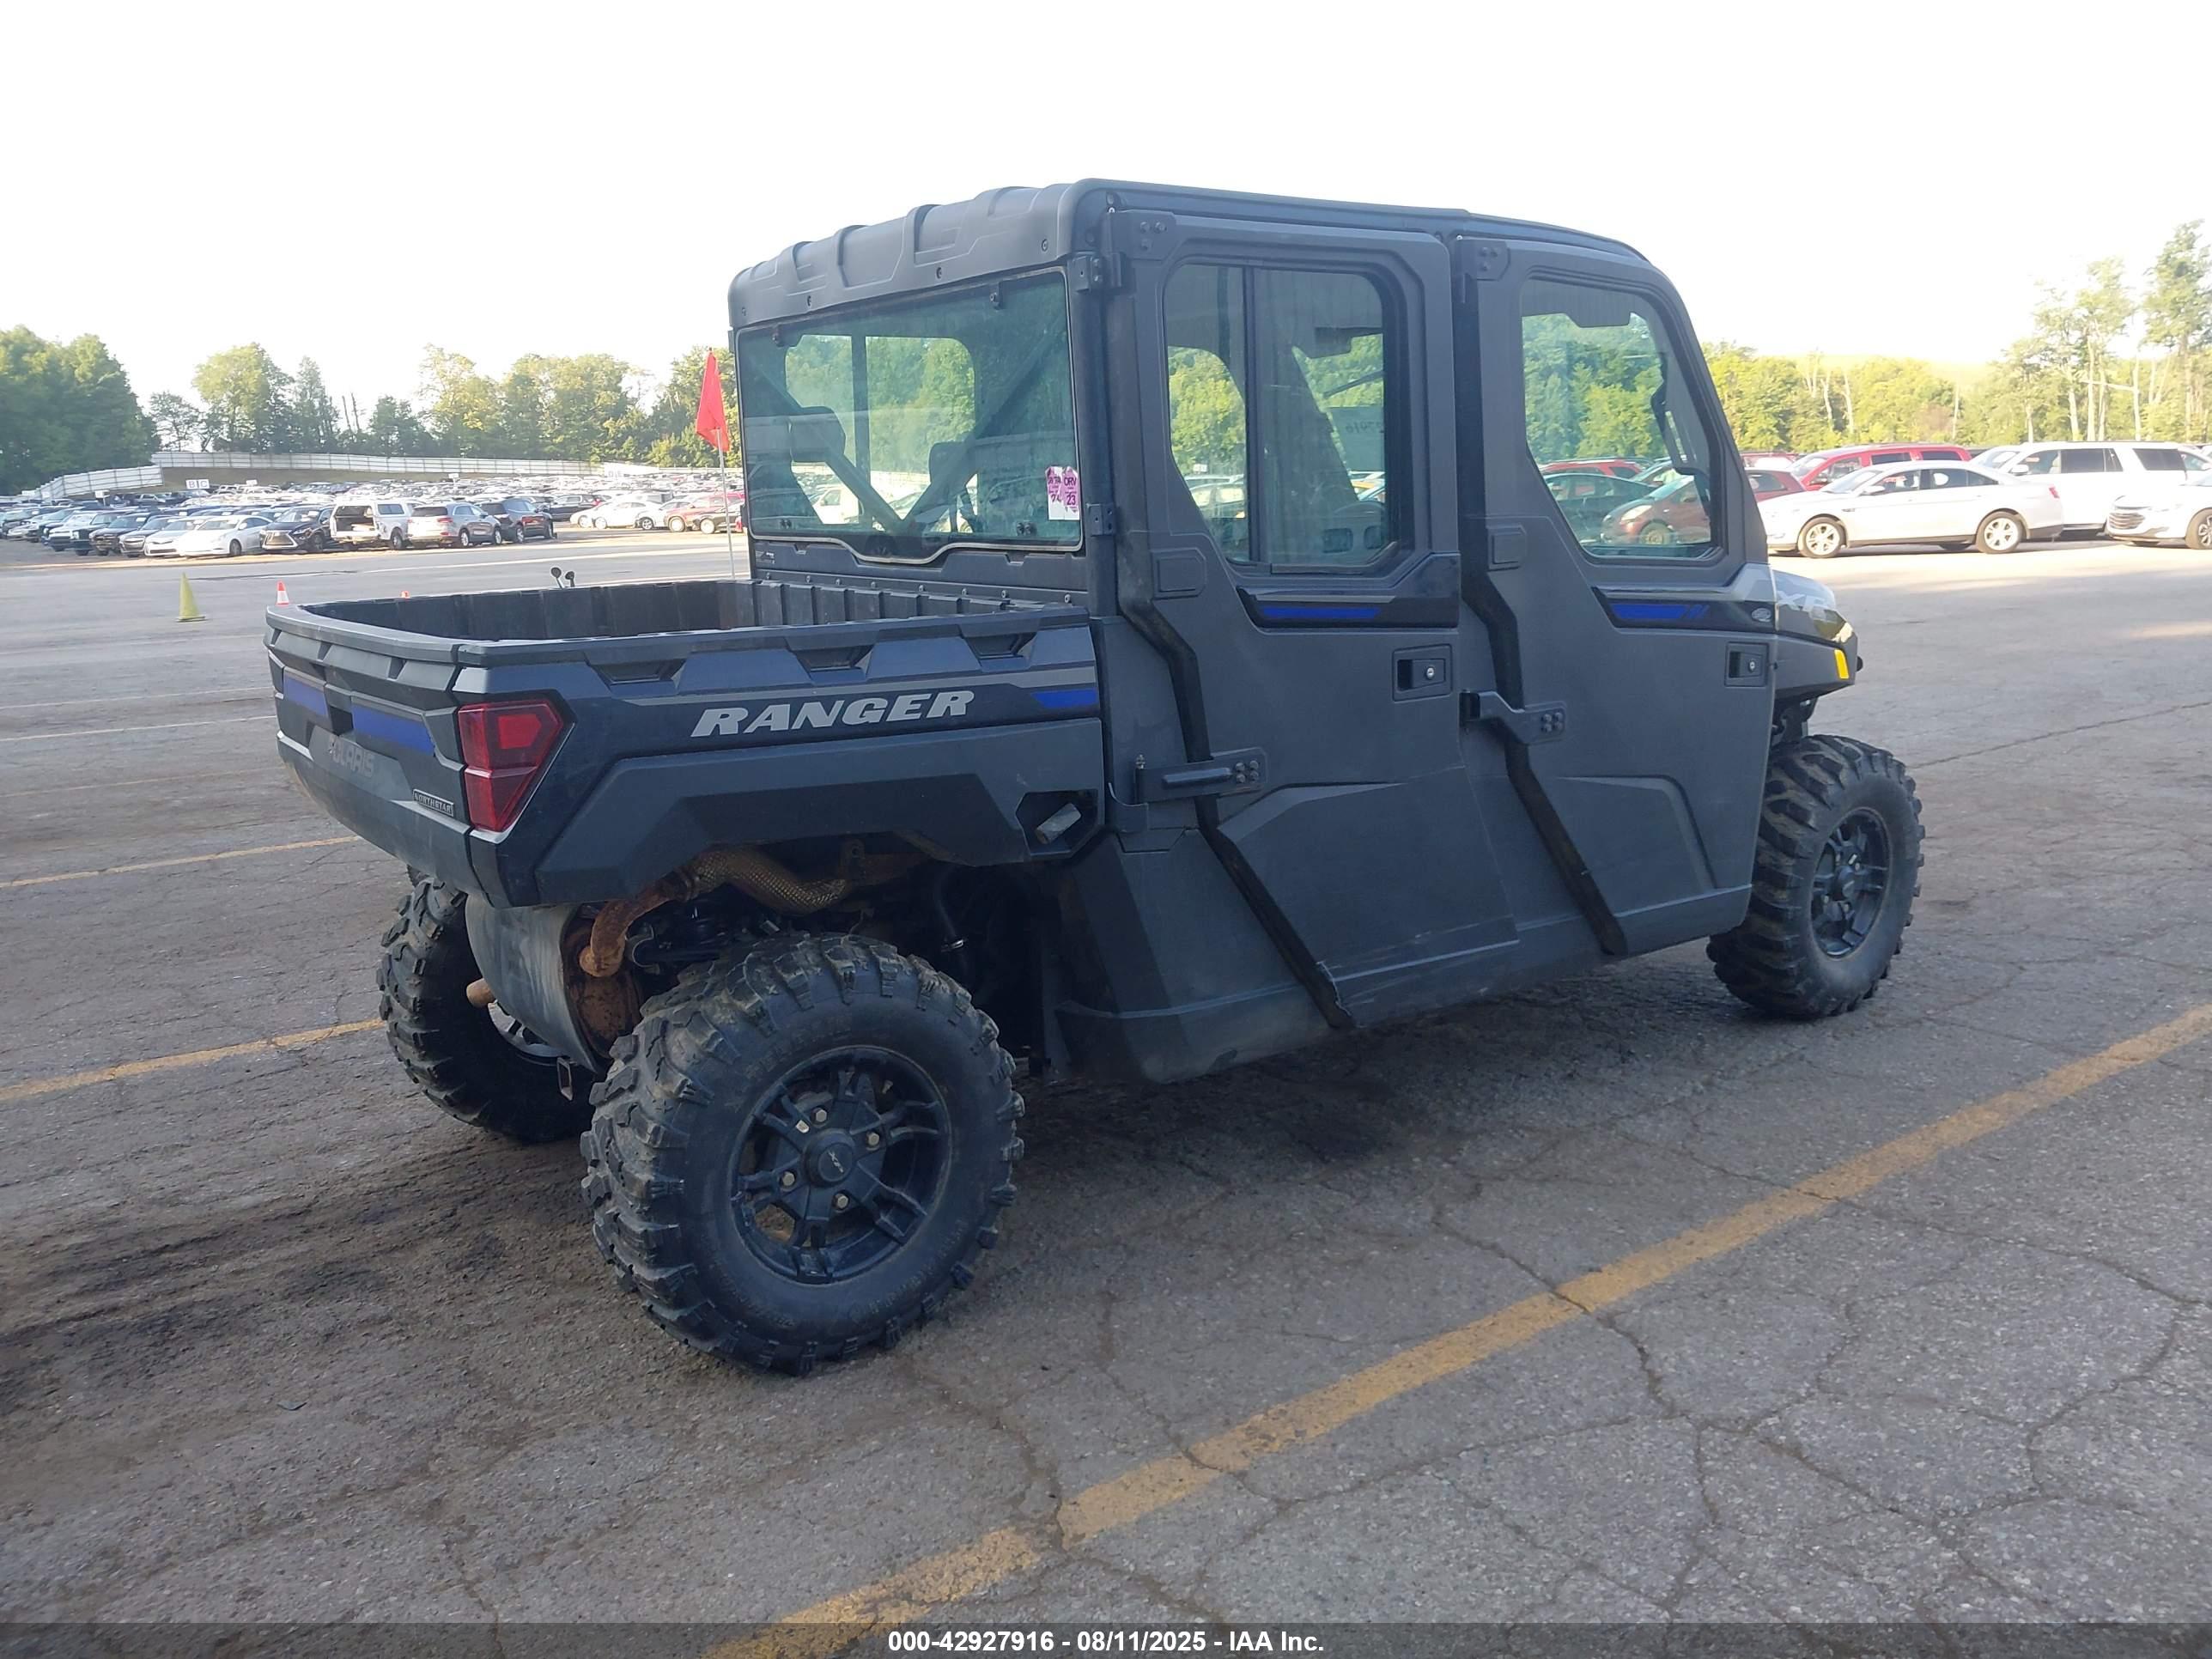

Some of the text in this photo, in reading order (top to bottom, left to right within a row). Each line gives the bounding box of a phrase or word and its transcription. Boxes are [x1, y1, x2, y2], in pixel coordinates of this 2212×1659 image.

[1064, 477, 1077, 486] ORV
[1066, 495, 1076, 505] 23
[690, 690, 975, 738] RANGER
[329, 735, 374, 778] POLARIS
[414, 792, 452, 814] NORTHSTAR
